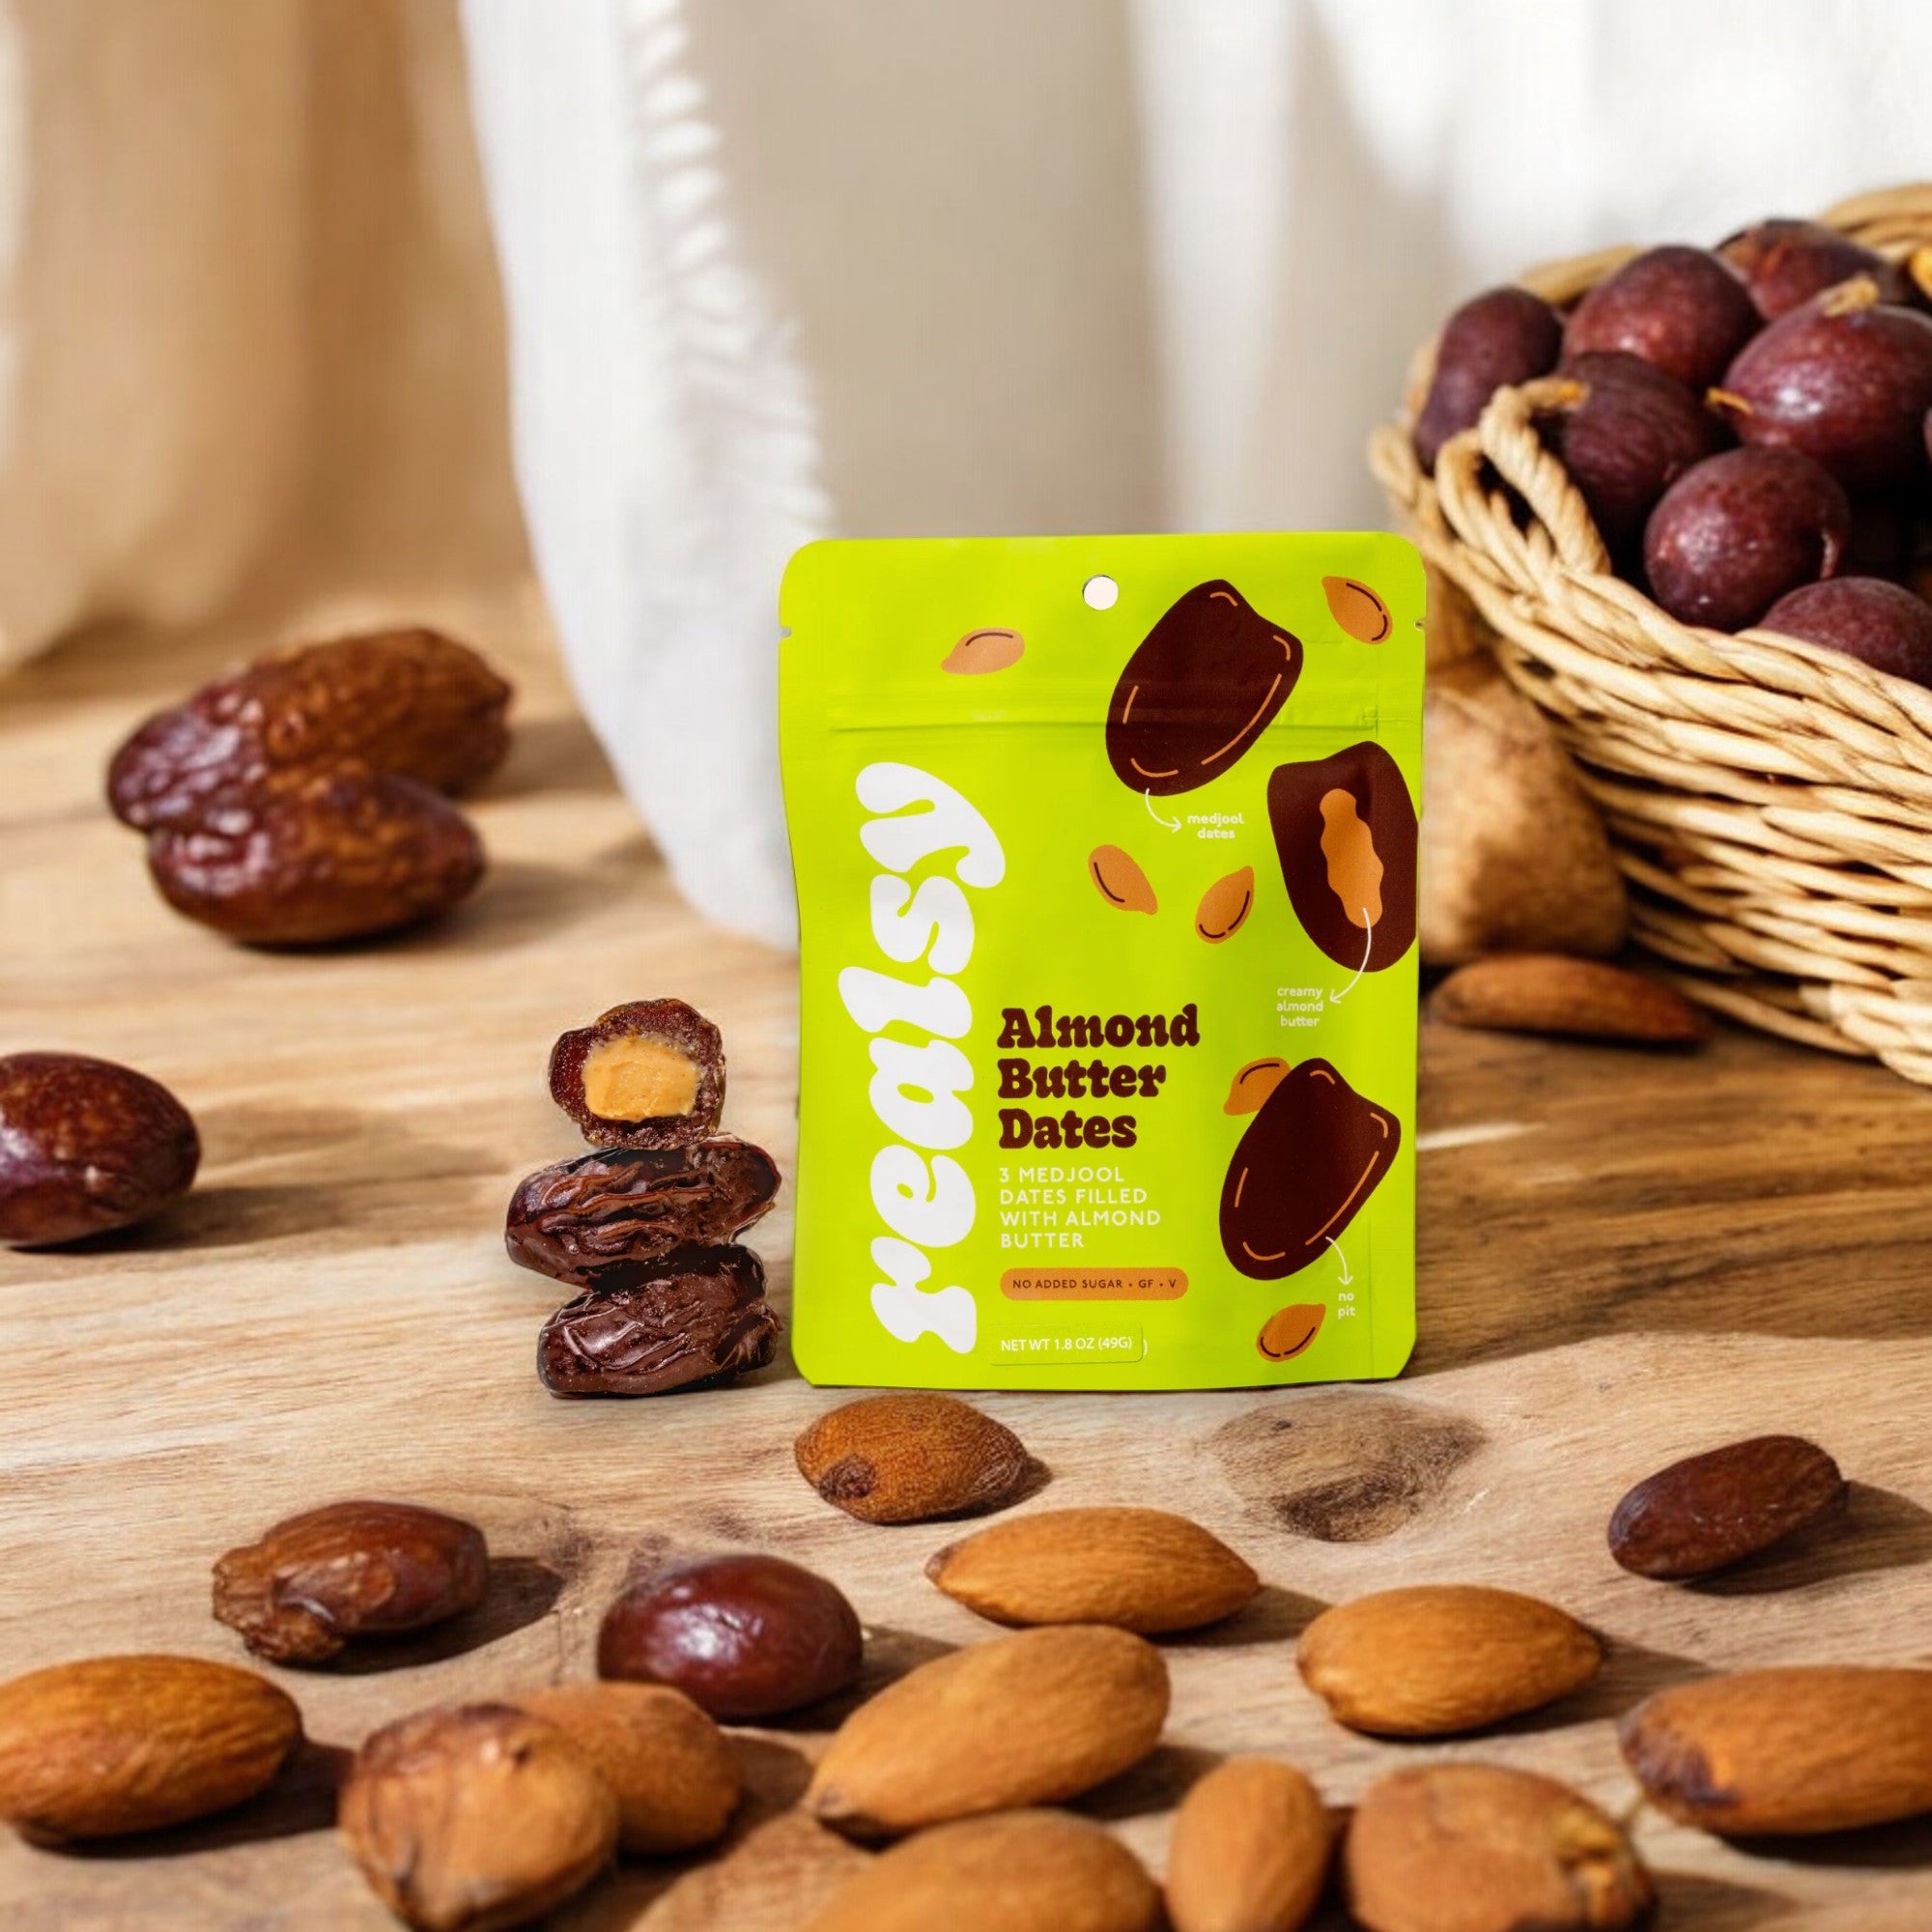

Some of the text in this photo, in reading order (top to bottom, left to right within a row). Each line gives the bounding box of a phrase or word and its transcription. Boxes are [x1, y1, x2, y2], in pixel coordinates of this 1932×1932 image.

[1187, 812, 1244, 828] medjool
[1197, 827, 1236, 839] dates
[1277, 987, 1323, 1000] creamy
[1276, 1000, 1324, 1012] almond
[996, 1003, 1201, 1049] Almond
[1280, 1015, 1320, 1027] butter
[838, 761, 1007, 1354] realsy
[997, 1057, 1167, 1099] Butter
[998, 1107, 1138, 1150] Dates
[999, 1166, 1125, 1183] 3 MEDJOOL
[1000, 1187, 1148, 1206] DATES FILLED
[1000, 1209, 1161, 1227] WITH ALMOND
[1001, 1232, 1084, 1249] BUTTER
[1012, 1278, 1178, 1290] NO ADDED SUGAR GF V
[1338, 1293, 1354, 1301] no
[1337, 1304, 1356, 1321] pit
[1001, 1339, 1026, 1351] NET
[1029, 1338, 1051, 1351] WT
[1055, 1338, 1072, 1350] 1.8
[1075, 1337, 1095, 1350] OZ
[1097, 1336, 1133, 1350] (49G)
